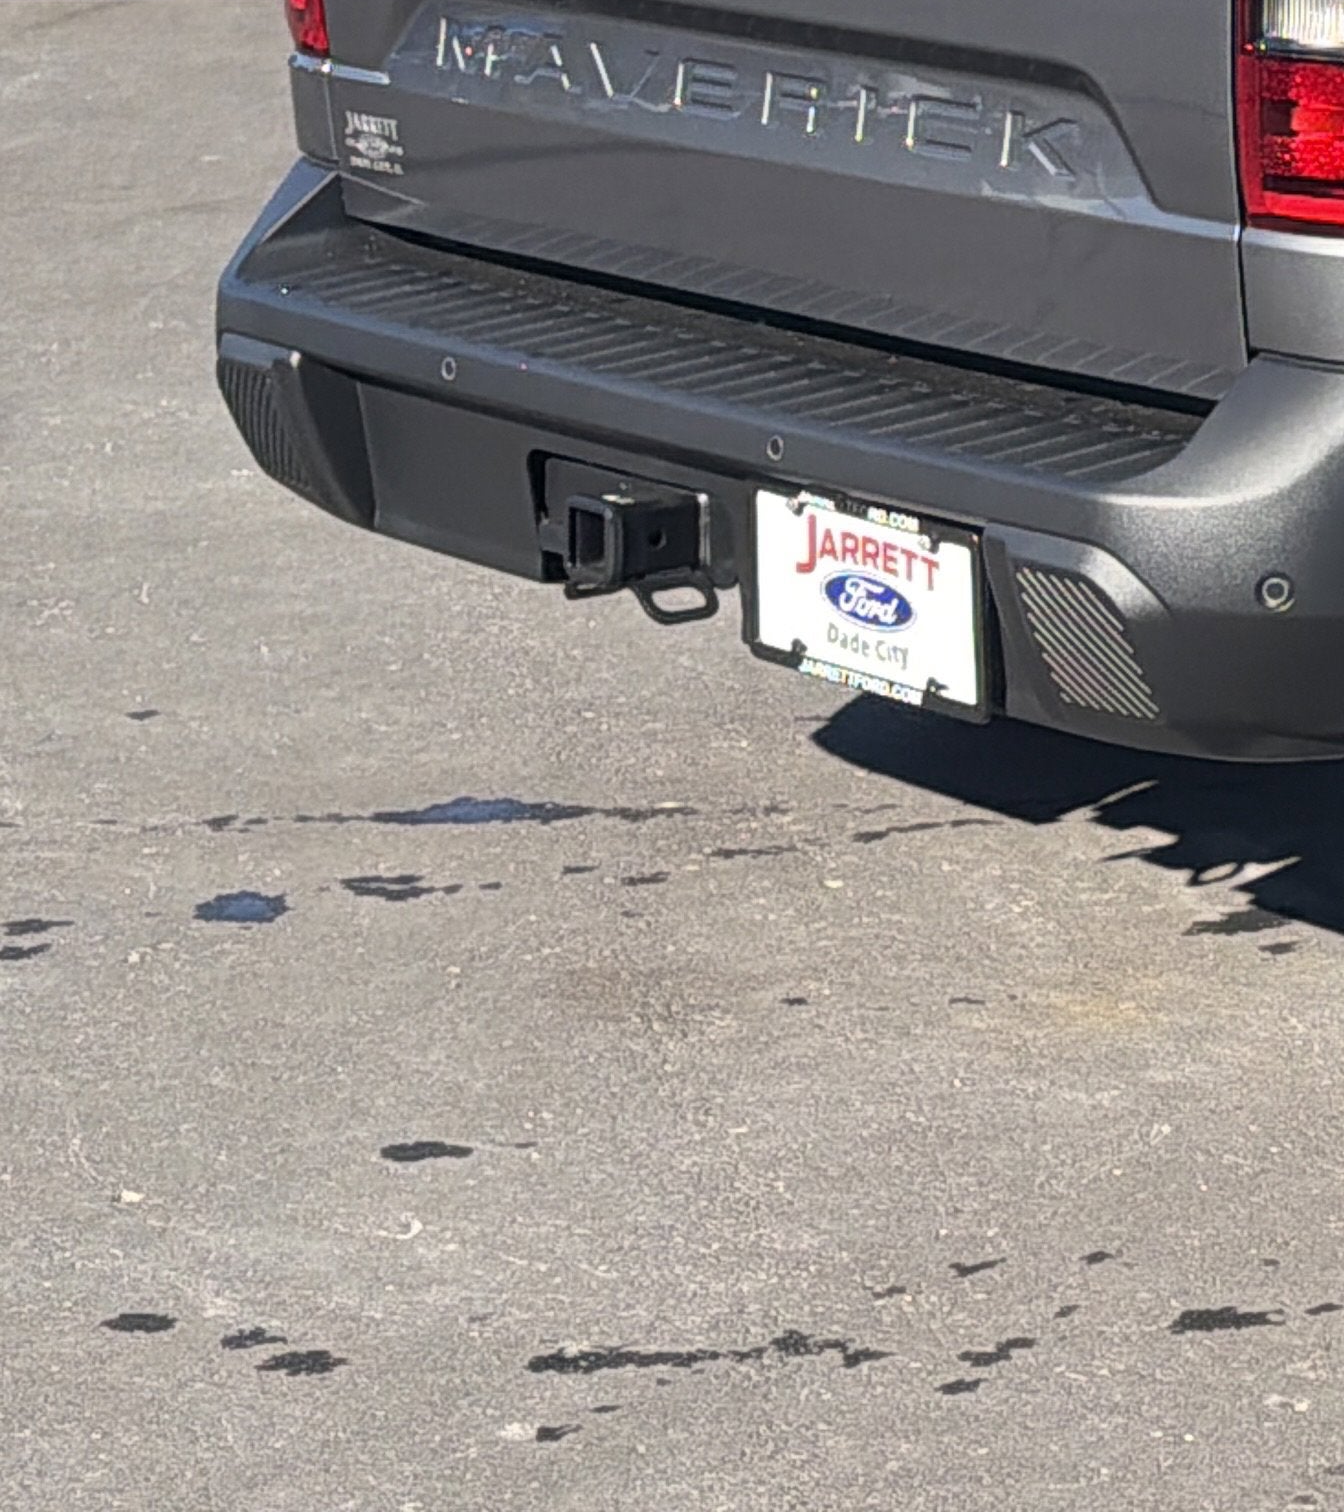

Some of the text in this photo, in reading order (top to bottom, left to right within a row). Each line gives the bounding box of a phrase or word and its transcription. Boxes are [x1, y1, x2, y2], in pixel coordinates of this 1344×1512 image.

[436, 15, 1079, 183] MAVERICK
[796, 513, 940, 591] JARRETT
[839, 577, 900, 624] Ford
[827, 622, 909, 670] Dade City
